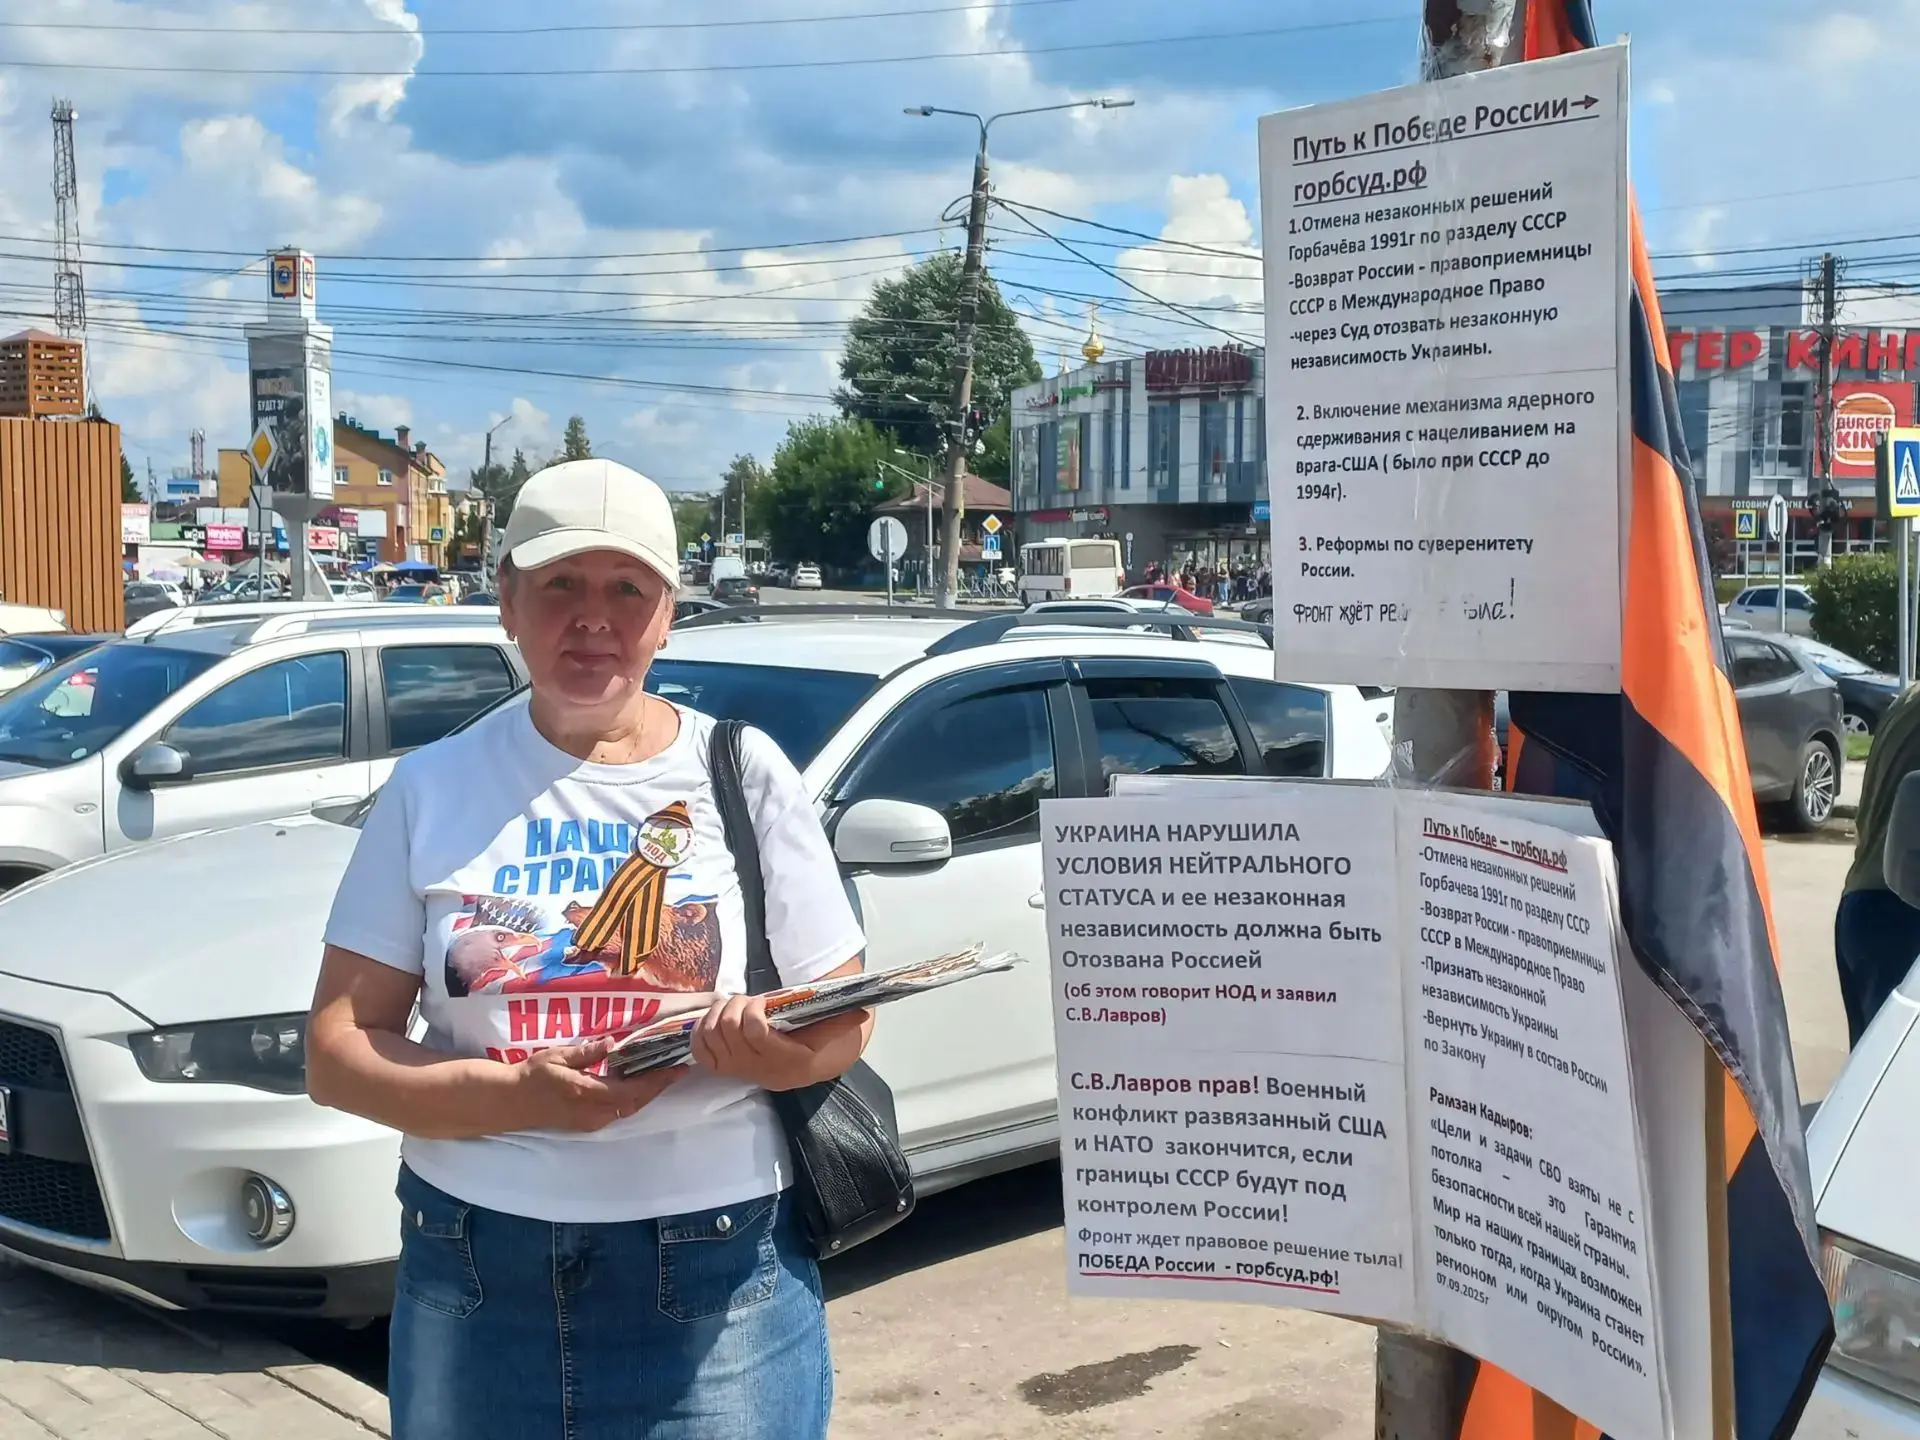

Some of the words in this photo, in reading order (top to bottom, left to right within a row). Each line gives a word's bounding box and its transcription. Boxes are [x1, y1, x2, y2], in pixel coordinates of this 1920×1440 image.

[1293, 134, 1345, 162] Путь
[1374, 115, 1466, 147] Победе
[1475, 98, 1568, 130] России
[1294, 160, 1427, 202] горбсуд.рф
[1289, 213, 1360, 234] 1.Отмена
[1365, 198, 1464, 224] незаконных
[1471, 183, 1552, 212] решений
[1288, 239, 1365, 261] Горбачёва
[1371, 232, 1414, 250] 1991г
[1420, 229, 1440, 245] по
[1446, 221, 1517, 245] разделу
[1522, 211, 1566, 231] СССР
[1288, 271, 1354, 290] -Возврат
[1358, 262, 1414, 281] России
[1431, 244, 1592, 276] правоприемницы
[1289, 300, 1324, 316] СССР
[1342, 284, 1483, 310] Международное
[1489, 277, 1545, 296] Право
[1290, 327, 1336, 343] -через
[1340, 323, 1369, 340] Суд
[1374, 318, 1445, 336] отозвать
[1450, 306, 1558, 329] незаконную
[1291, 349, 1407, 370] независимость
[1412, 342, 1492, 362] Украины.
[1666, 331, 1763, 369] ГЕР
[1313, 403, 1401, 419] Включение
[1406, 397, 1502, 415] механизма
[1507, 390, 1594, 410] ядерного
[1297, 429, 1401, 449] сдерживания
[1418, 421, 1548, 443] нацеливанием
[1554, 421, 1576, 434] на
[1837, 417, 1891, 429] BURGER
[1837, 431, 1876, 448] KIN
[1296, 455, 1378, 476] врага-США
[1392, 454, 1436, 470] было
[1441, 455, 1474, 472] при
[1479, 450, 1521, 466] СССР
[1526, 452, 1549, 469] до
[1297, 483, 1347, 501] 1994г).
[1316, 538, 1389, 554] Реформы
[1394, 538, 1413, 550] по
[1418, 537, 1533, 554] суверенитету
[1301, 563, 1354, 578] России.
[525, 819, 638, 858] НАШ
[1055, 825, 1160, 843] УКРАИНА
[1168, 823, 1300, 842] НАРУШИЛА
[1424, 818, 1450, 838] Путь
[1461, 822, 1497, 848] Победе
[1511, 839, 1568, 868] горбсуд.рф
[644, 843, 667, 863] НОД
[1057, 856, 1162, 875] УСЛОВИЯ
[1170, 852, 1351, 875] НЕЙТРАЛЬНОГО
[1419, 846, 1468, 869] -Отмена
[1470, 858, 1528, 885] незаконных
[1530, 875, 1576, 901] решений
[1059, 888, 1154, 907] СТАТУСА
[1182, 892, 1207, 906] ее
[1214, 891, 1346, 908] незаконная
[1420, 872, 1478, 899] Горбачева
[1481, 886, 1508, 906] 1991г
[1510, 898, 1523, 911] по
[1526, 900, 1564, 930] разделу
[1567, 914, 1590, 936] СССР
[1061, 922, 1228, 938] независимость
[1234, 922, 1322, 941] должна
[1329, 922, 1382, 942] быть
[1420, 901, 1472, 925] -Возврат
[1475, 914, 1509, 937] России
[1518, 929, 1606, 975] правоприемницы
[1062, 951, 1165, 968] Отозвана
[1172, 951, 1262, 969] Россией
[1420, 928, 1451, 946] СССР
[1465, 936, 1552, 980] Международное
[1553, 966, 1585, 994] Право
[1064, 983, 1090, 1000] (об
[1096, 986, 1137, 998] этом
[1142, 986, 1210, 1003] говорит
[1216, 986, 1256, 1001] НОД
[1277, 988, 1337, 1003] заявил
[1421, 956, 1484, 983] -Признать
[1486, 972, 1546, 1006] незаконной
[1066, 1008, 1167, 1026] С.В.Лавров)
[1422, 985, 1510, 1020] независимость
[1512, 1008, 1558, 1040] Украины
[1423, 1010, 1478, 1037] -Вернуть
[1481, 1024, 1524, 1057] Украину
[1536, 1050, 1569, 1074] состав
[1571, 1061, 1608, 1094] России
[1424, 1038, 1438, 1052] по
[1442, 1040, 1486, 1069] Закону
[1071, 1073, 1191, 1096] С.В.Лавров
[1199, 1075, 1260, 1096] прав!
[1267, 1077, 1366, 1102] Военный
[1073, 1104, 1178, 1126] конфликт
[1185, 1110, 1331, 1132] развязанный
[1338, 1115, 1387, 1139] США
[1430, 1086, 1476, 1116] Рамзан
[1480, 1104, 1532, 1140] Кадыров:
[1094, 1135, 1153, 1153] НАТО
[1165, 1142, 1296, 1163] закончится,
[1302, 1149, 1352, 1166] если
[1430, 1118, 1471, 1142] «Цели
[1494, 1141, 1532, 1168] задачи
[1539, 1159, 1561, 1182] СВО
[1568, 1177, 1600, 1205] взяты
[1608, 1198, 1622, 1216] не
[1076, 1169, 1169, 1188] границы
[1176, 1169, 1229, 1187] СССР
[1236, 1170, 1299, 1195] будут
[1305, 1180, 1347, 1202] под
[1431, 1146, 1482, 1172] потолка
[1548, 1195, 1566, 1214] это
[1585, 1211, 1636, 1255] Гарантия
[1078, 1199, 1197, 1220] контролем
[1204, 1202, 1288, 1222] России!
[1431, 1168, 1515, 1214] безопасности
[1518, 1208, 1542, 1230] всей
[1545, 1221, 1580, 1250] нашей
[1583, 1242, 1630, 1280] страны.
[1078, 1228, 1132, 1246] Фронт
[1137, 1232, 1181, 1249] ждет
[1186, 1235, 1268, 1252] правовое
[1273, 1240, 1349, 1262] решение
[1354, 1250, 1402, 1269] тыла!
[1433, 1196, 1460, 1223] Мир
[1466, 1211, 1481, 1228] на
[1486, 1221, 1523, 1248] наших
[1527, 1239, 1578, 1279] границах
[1580, 1270, 1642, 1316] возможен
[1079, 1254, 1150, 1272] ПОБЕДА
[1155, 1257, 1215, 1273] России
[1236, 1263, 1339, 1286] горбсуд.рф!
[1434, 1224, 1476, 1252] только
[1480, 1242, 1516, 1273] тогда,
[1520, 1263, 1551, 1290] когда
[1554, 1278, 1601, 1322] Украина
[1605, 1312, 1644, 1346] станет
[1436, 1272, 1489, 1305] 07.09.2025г
[1436, 1250, 1497, 1288] регионом
[1506, 1282, 1528, 1304] или
[1537, 1300, 1583, 1339] округом
[1592, 1330, 1647, 1377] России».
